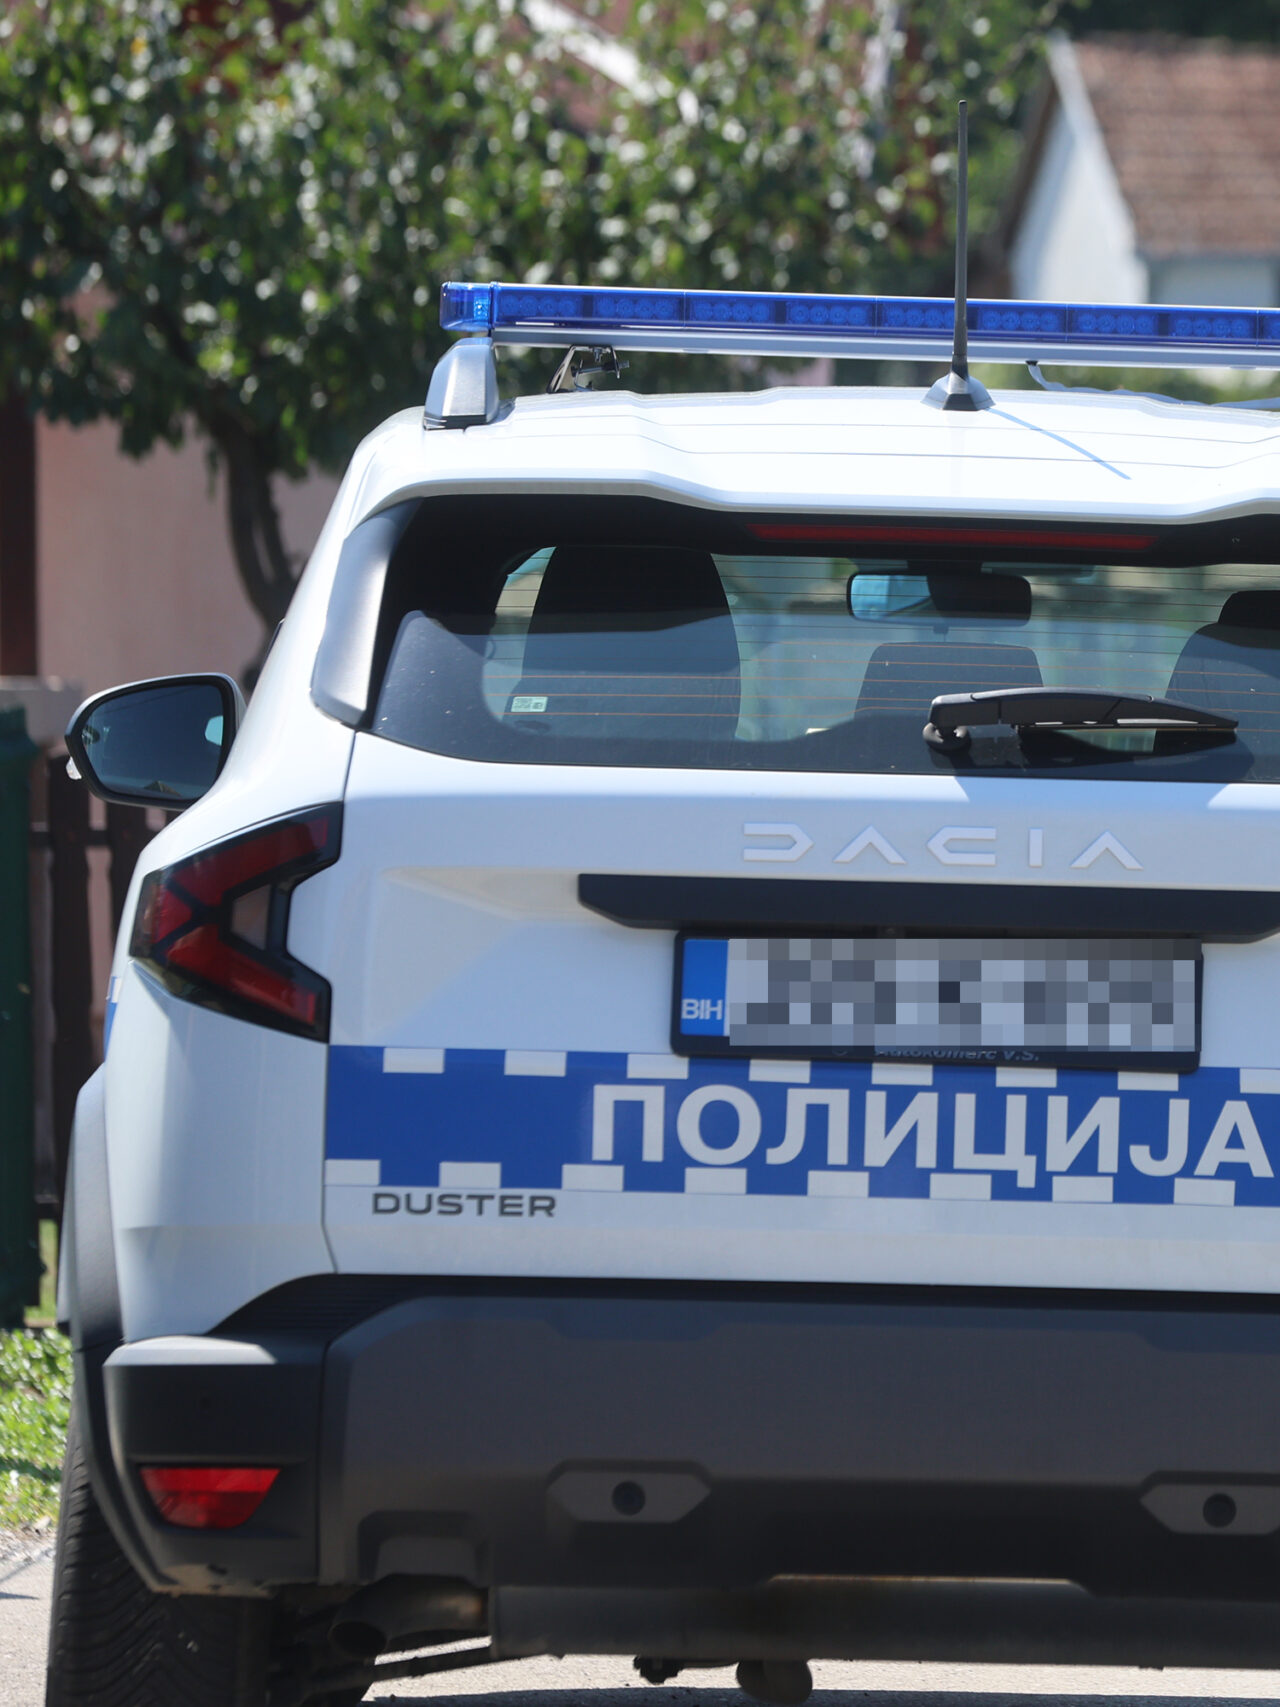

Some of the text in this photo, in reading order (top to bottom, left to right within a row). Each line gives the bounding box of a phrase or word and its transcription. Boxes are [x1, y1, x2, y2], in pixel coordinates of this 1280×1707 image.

[743, 822, 1144, 871] DACIA
[681, 998, 724, 1020] BIH
[591, 1083, 1275, 1189] ПОЛИЦИЈА
[371, 1192, 557, 1218] DUSTER
